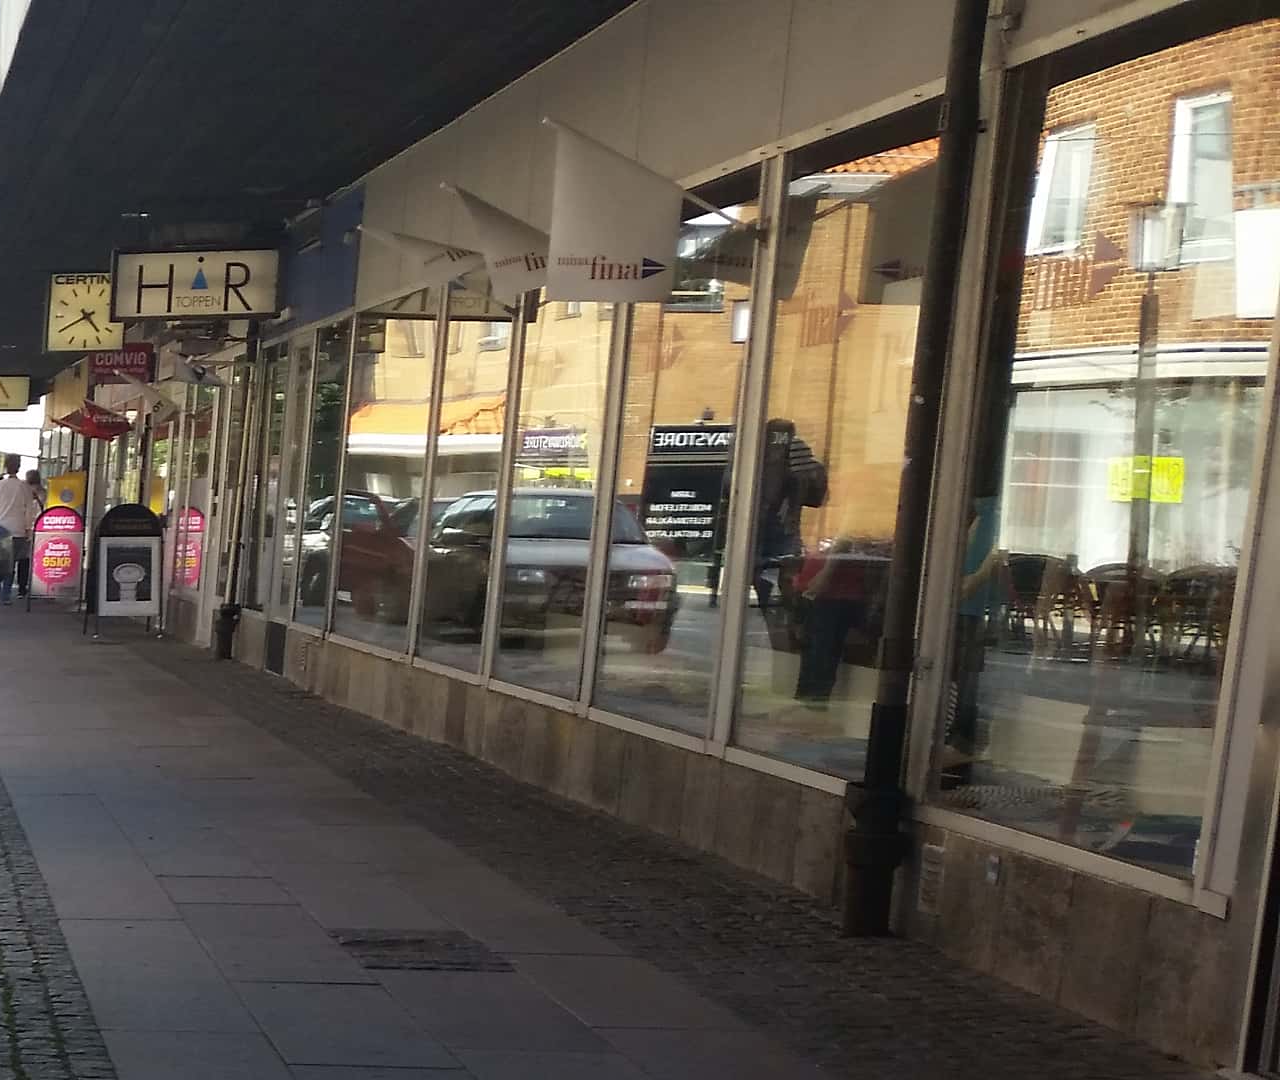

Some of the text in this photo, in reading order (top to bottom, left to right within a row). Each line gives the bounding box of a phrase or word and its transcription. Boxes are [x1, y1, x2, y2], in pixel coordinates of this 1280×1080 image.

[589, 256, 640, 280] fina
[55, 275, 111, 285] CERTIN
[176, 295, 221, 308] TOPPEN
